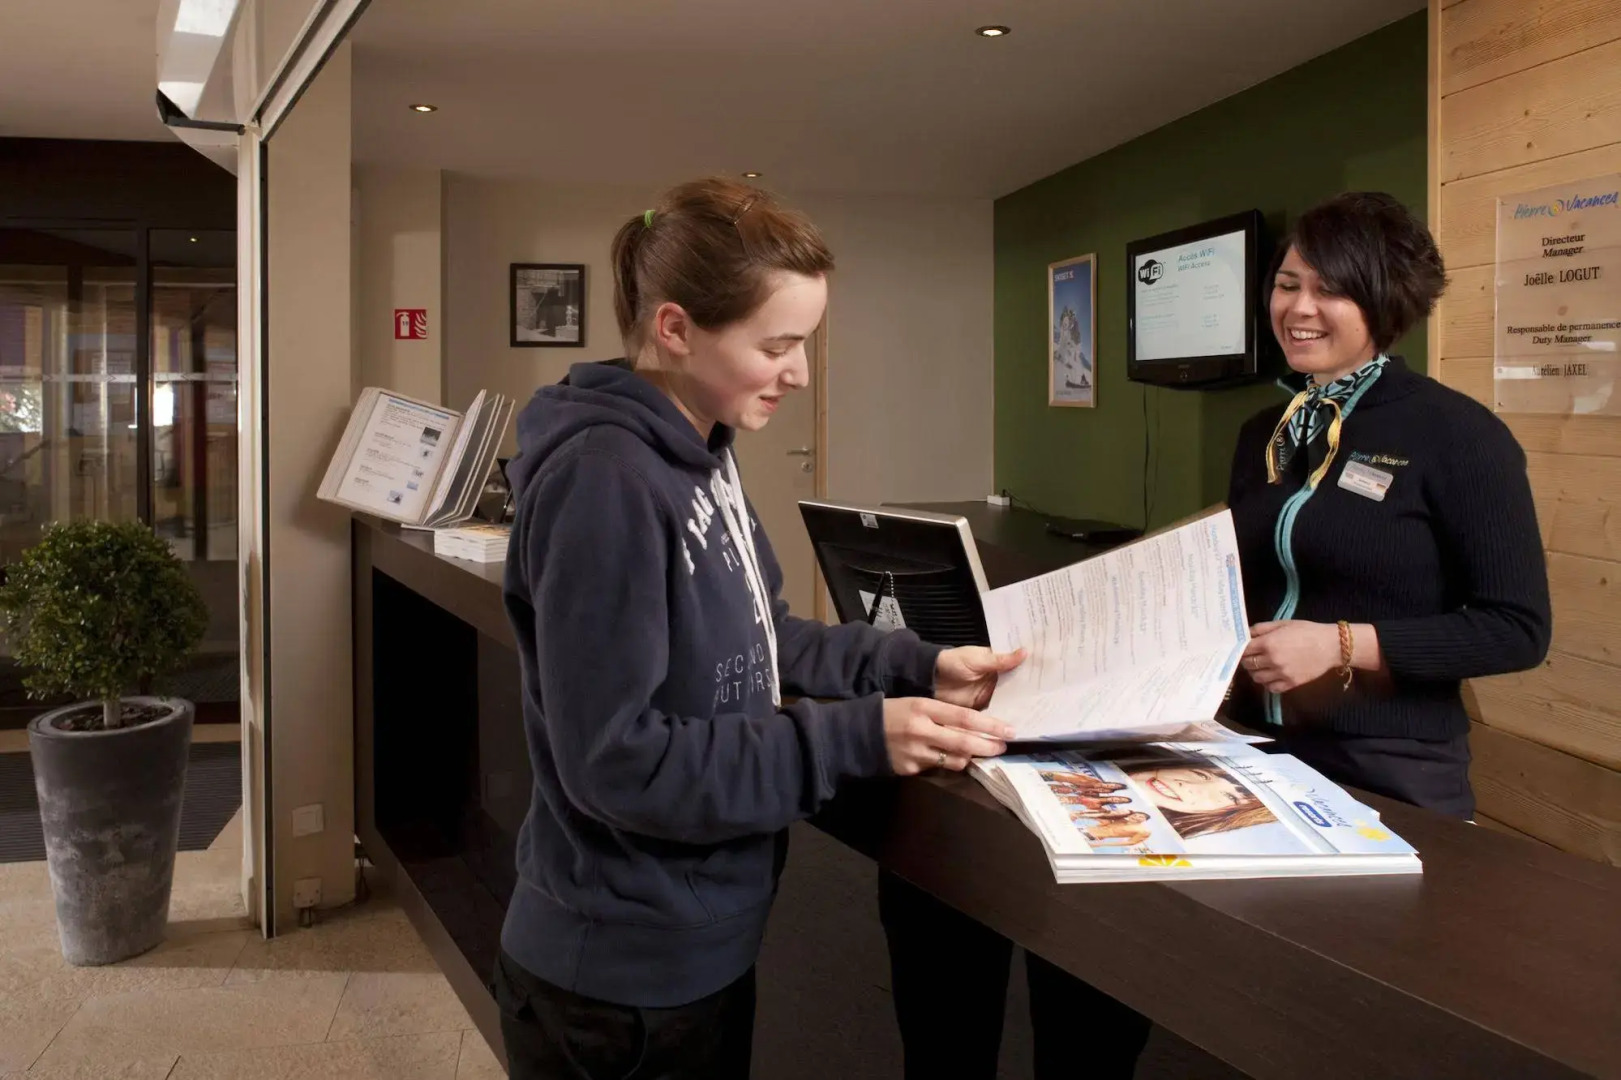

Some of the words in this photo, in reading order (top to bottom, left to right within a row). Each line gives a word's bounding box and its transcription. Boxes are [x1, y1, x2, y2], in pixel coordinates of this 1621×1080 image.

[1566, 191, 1619, 212] Vacances
[1542, 234, 1586, 247] Directeur
[1542, 246, 1584, 259] Manager
[1524, 272, 1554, 287] Joëlle
[1559, 266, 1600, 283] LOGUT
[1507, 323, 1555, 336] Responsable
[1557, 322, 1567, 331] de
[1569, 321, 1621, 333] permanence
[1532, 336, 1552, 346] Duty
[1554, 335, 1592, 345] Manager
[715, 643, 765, 683] SECND
